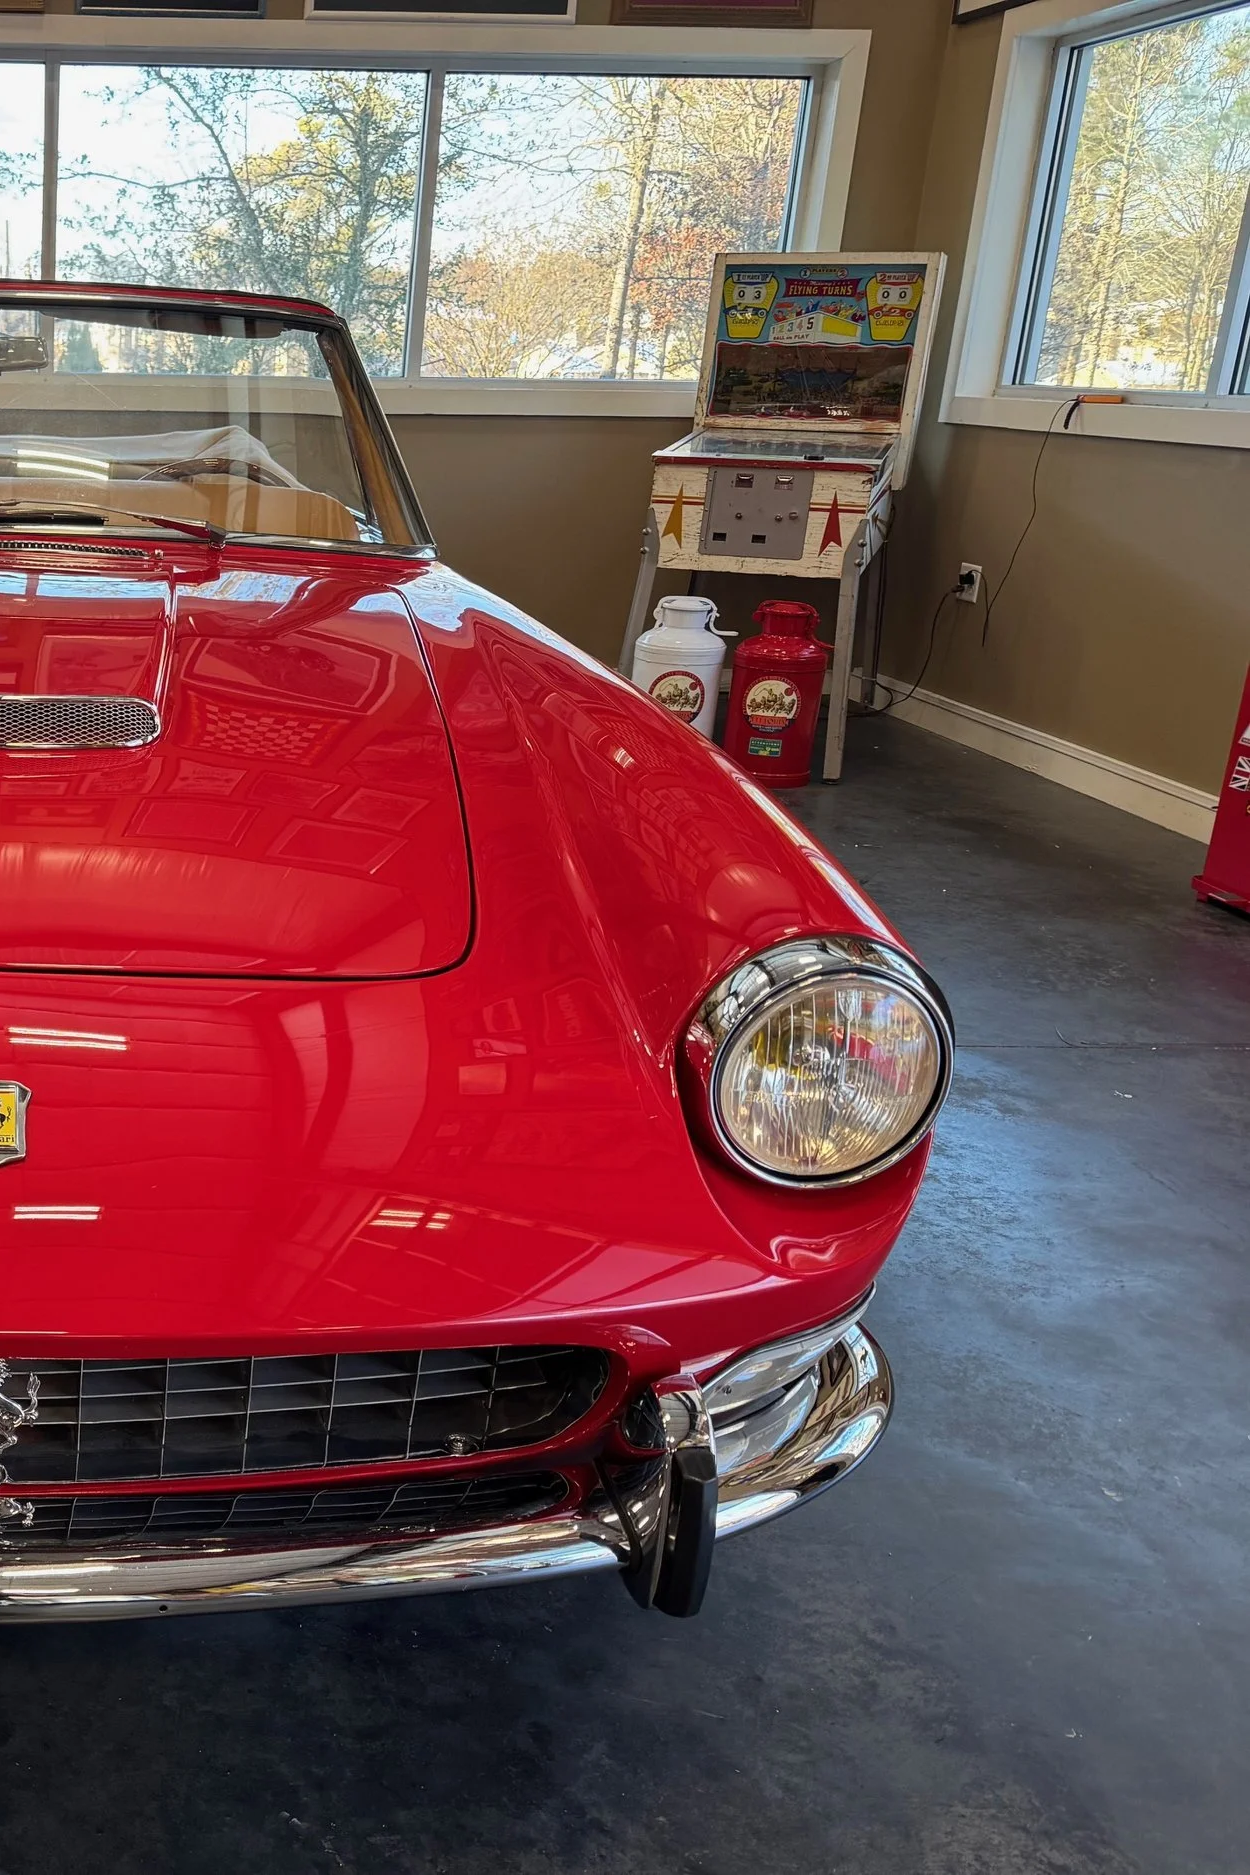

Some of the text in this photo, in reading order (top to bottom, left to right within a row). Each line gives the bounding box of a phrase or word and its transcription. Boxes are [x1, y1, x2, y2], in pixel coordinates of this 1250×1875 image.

[738, 290, 761, 299] 0 3
[789, 285, 853, 295] FLYING TURNS
[882, 290, 907, 299] 0 0
[779, 325, 785, 333] 2
[787, 322, 794, 332] 3
[796, 319, 803, 331] 4
[806, 316, 815, 330] 5
